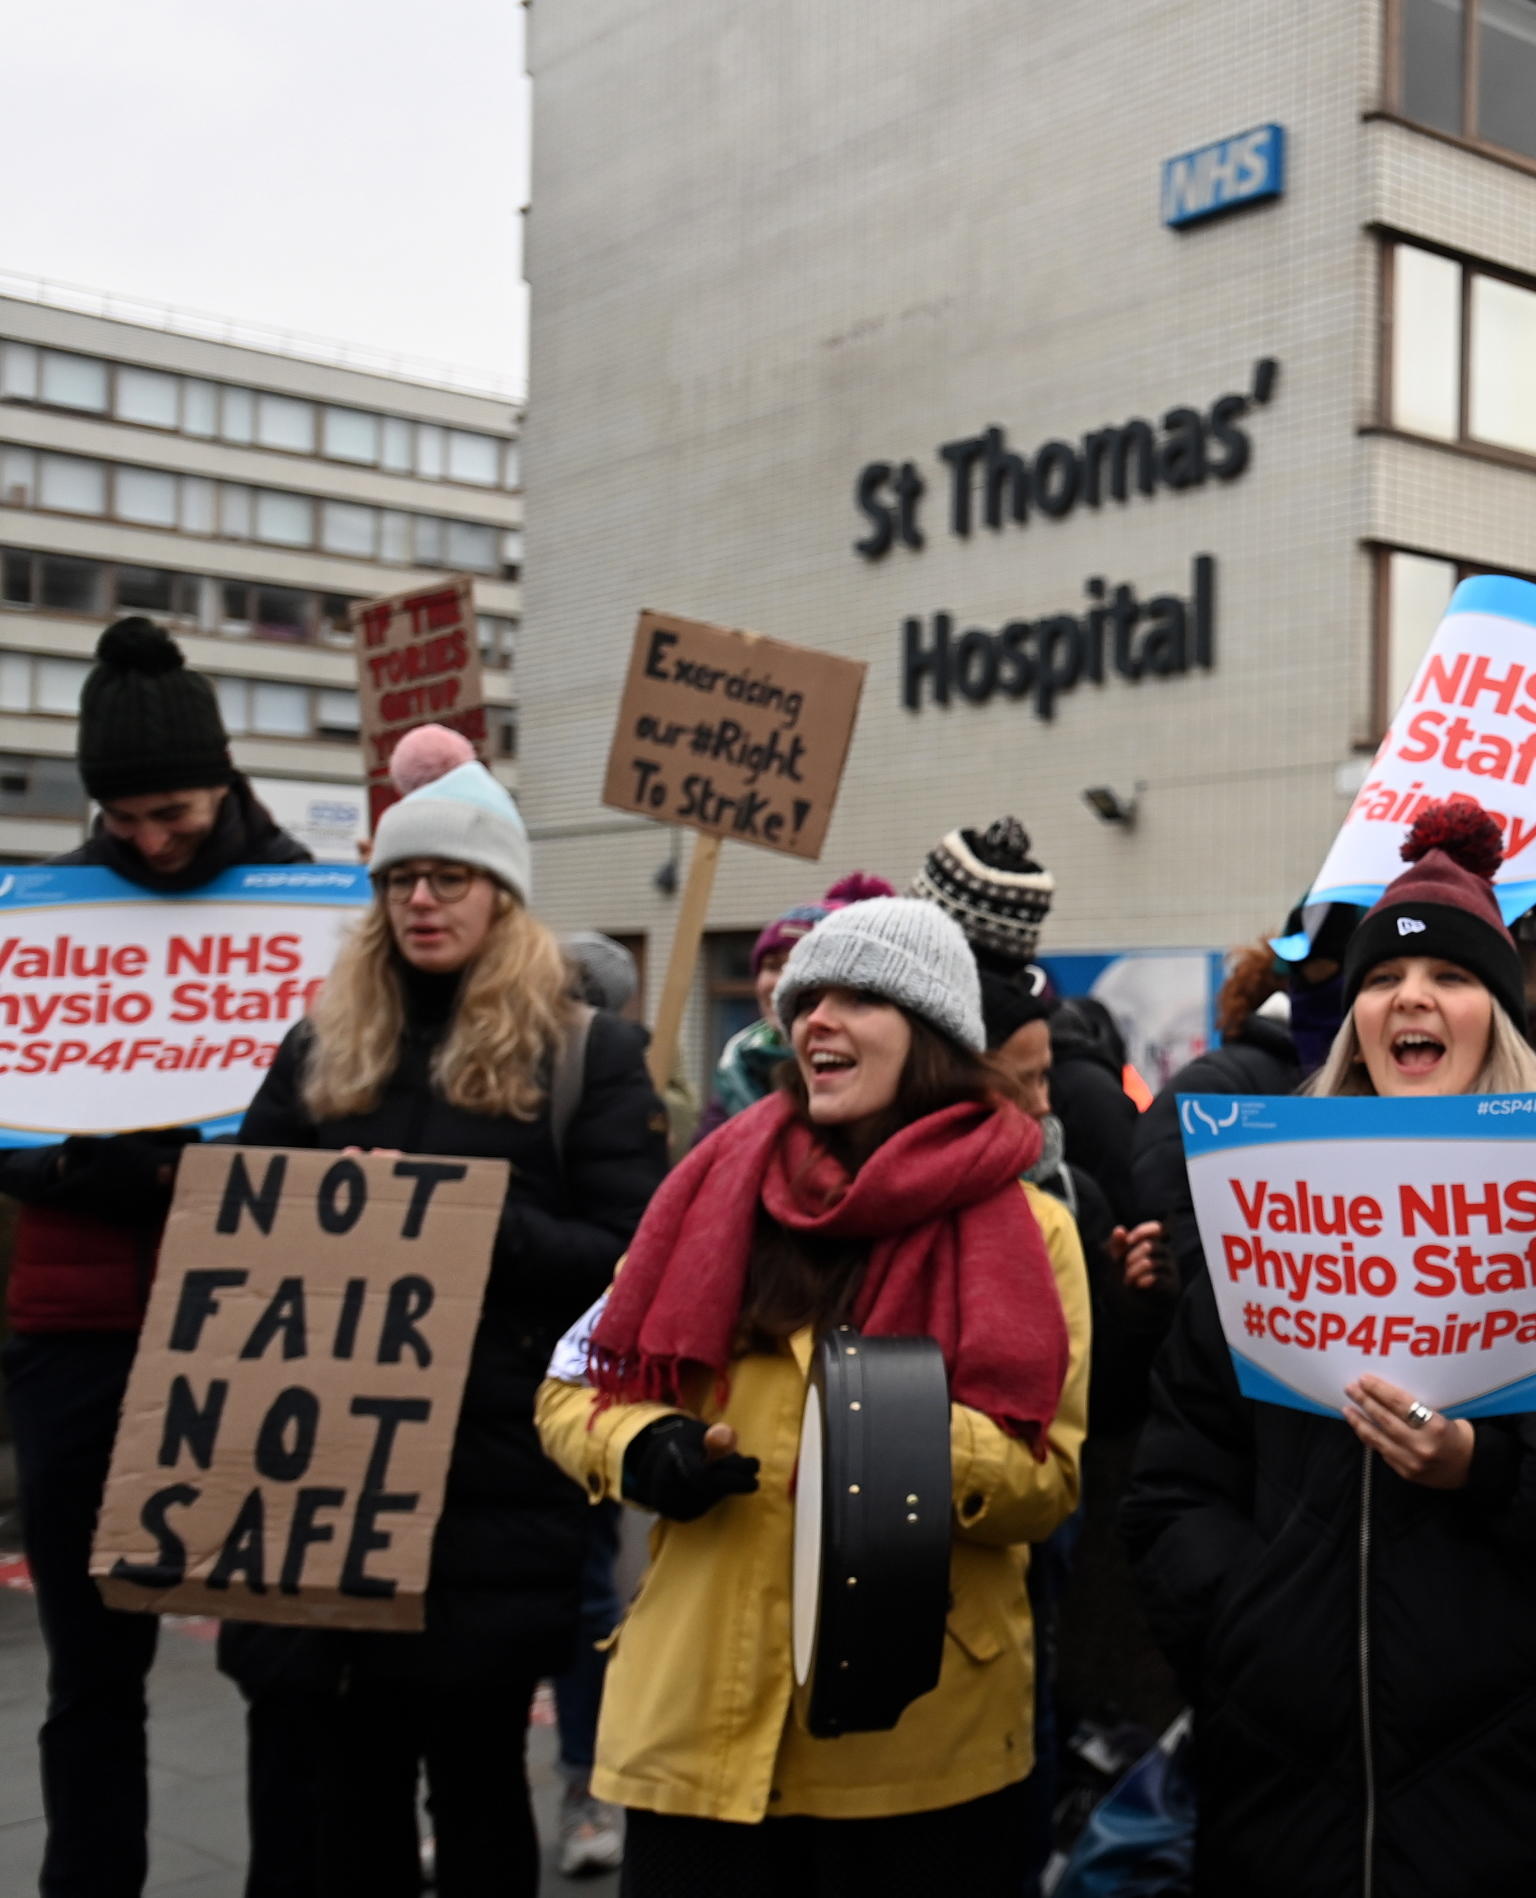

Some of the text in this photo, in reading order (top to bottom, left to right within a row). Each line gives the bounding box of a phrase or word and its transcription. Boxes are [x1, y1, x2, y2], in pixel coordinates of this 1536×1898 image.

[1162, 129, 1271, 219] NHS
[854, 461, 926, 561] St
[369, 629, 467, 689] TORIES
[903, 553, 1215, 722] Hospital
[632, 759, 667, 808] To
[165, 933, 303, 977] NHS
[215, 1152, 468, 1239] NOT
[1229, 1178, 1384, 1238] Value
[1221, 1233, 1397, 1302] Physio
[168, 1268, 435, 1370] FAIR
[157, 1374, 432, 1494] NOT
[110, 1483, 421, 1599] SAFE
